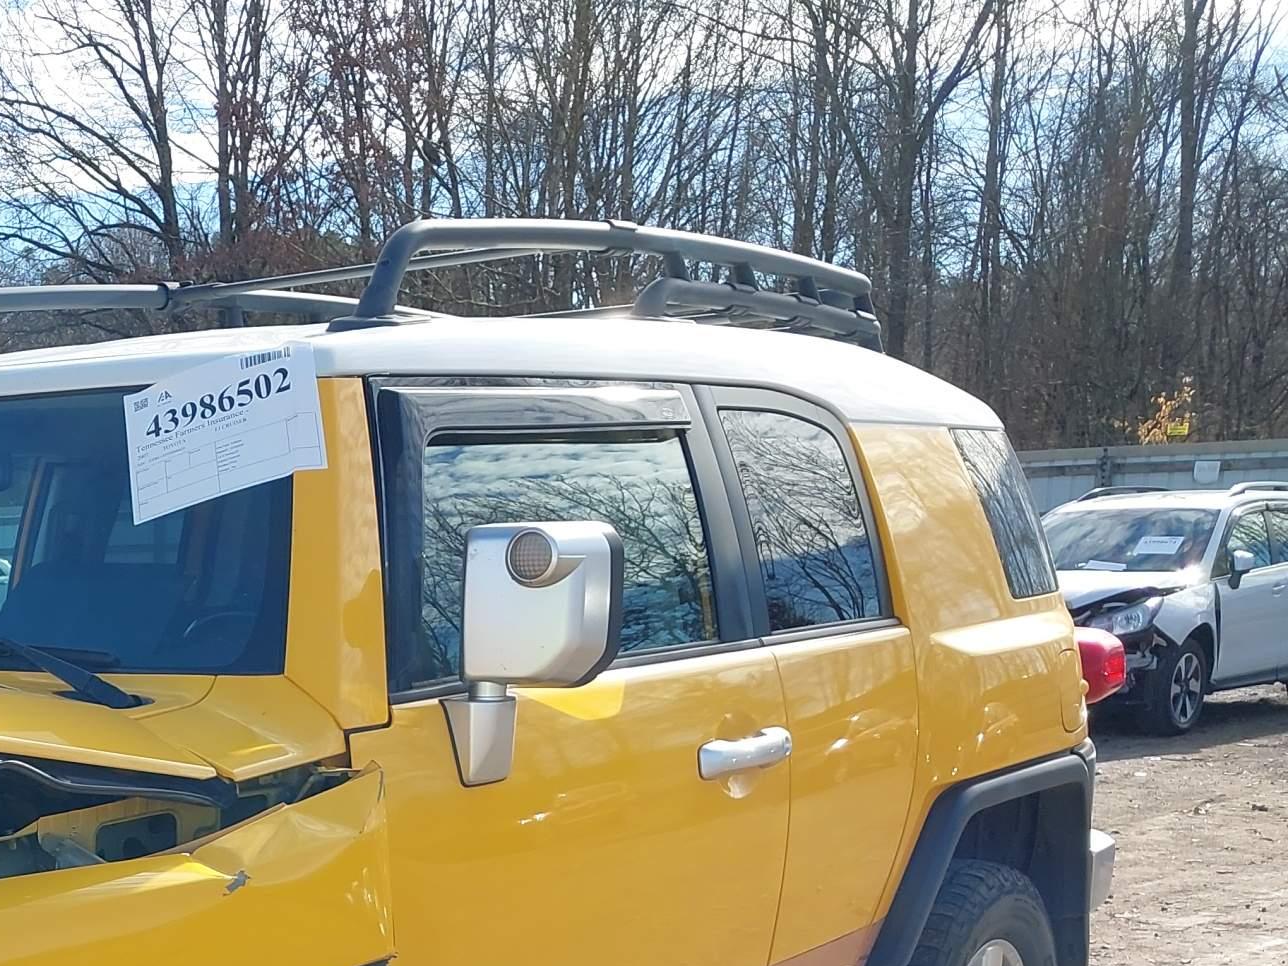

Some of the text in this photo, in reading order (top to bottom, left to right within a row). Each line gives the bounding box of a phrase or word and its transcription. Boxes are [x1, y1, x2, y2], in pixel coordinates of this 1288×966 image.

[145, 367, 292, 438] 43986502
[136, 435, 174, 453] Tennessee
[174, 424, 206, 439] Farmers
[207, 410, 244, 426] Insurance
